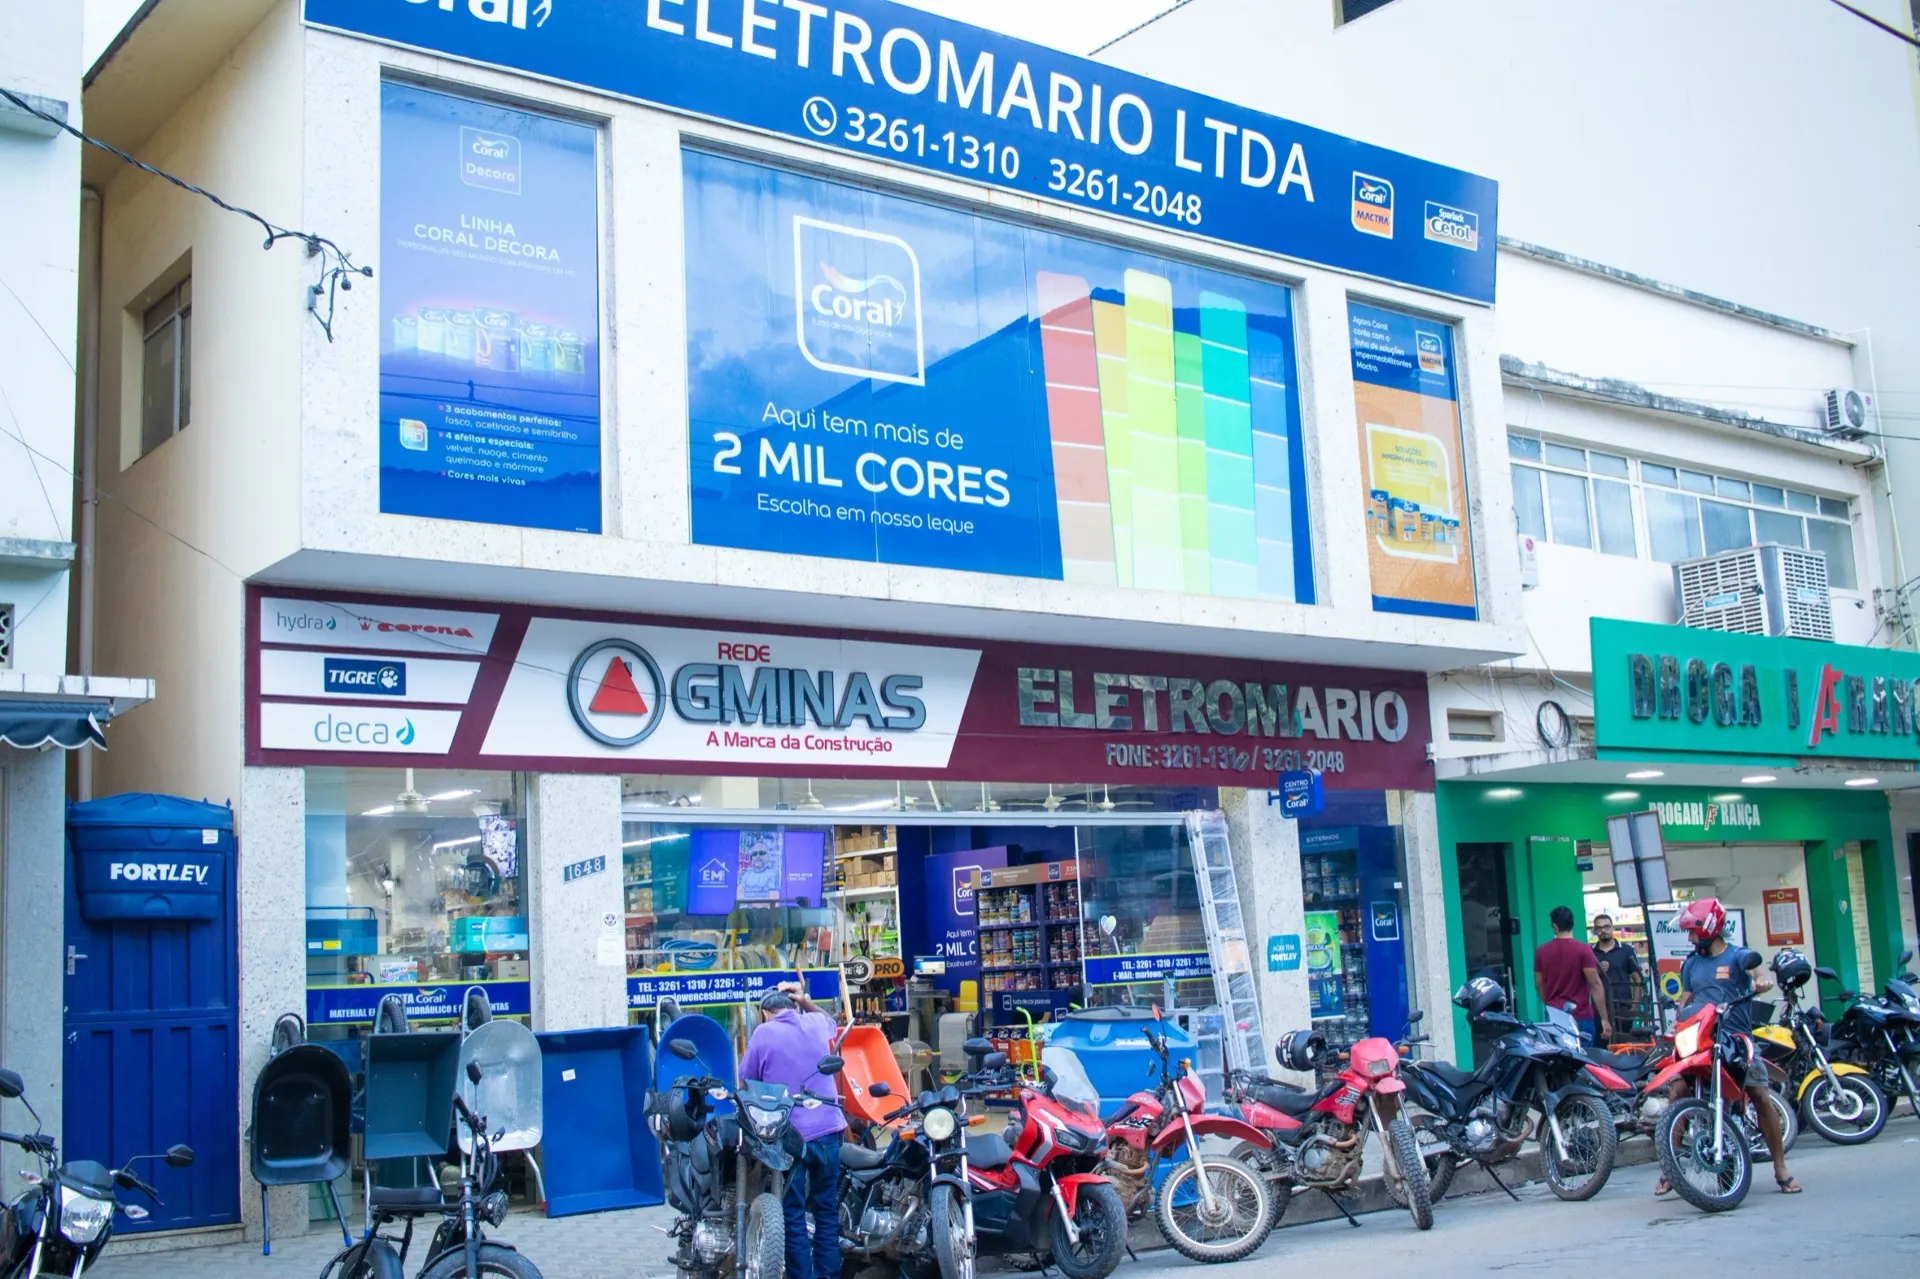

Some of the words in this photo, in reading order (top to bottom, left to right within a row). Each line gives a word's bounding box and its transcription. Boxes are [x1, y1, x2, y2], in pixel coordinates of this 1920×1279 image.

[472, 142, 504, 159] Coral
[1175, 109, 1315, 203] LTDA
[466, 163, 515, 182] Decora
[844, 107, 1020, 180] 3261-1310
[1048, 158, 1202, 226] 3261-2048
[1359, 188, 1384, 204] Coral
[461, 214, 516, 237] LINHA
[1356, 210, 1389, 225] MACTRA
[1430, 217, 1472, 241] Cetol
[414, 224, 479, 248] CORAL
[485, 236, 561, 263] DECORA
[811, 284, 893, 327] Coral
[446, 405, 452, 413] 3
[454, 407, 517, 422] acabamentos
[519, 414, 562, 428] perfeitos:
[762, 401, 816, 432] Aqui
[823, 409, 868, 438] tem
[874, 421, 929, 446] mais
[935, 427, 964, 451] de
[475, 420, 521, 433] acetinado
[531, 425, 578, 441] semibrilho
[446, 432, 452, 440] 4
[454, 432, 486, 444] efeitos
[488, 436, 534, 450] especiais:
[446, 443, 475, 455] velvet,
[478, 447, 510, 459] nuage,
[512, 450, 548, 463] cimento
[446, 455, 492, 468] queimado
[503, 459, 544, 474] mármore
[713, 432, 742, 475] 2
[759, 437, 843, 488] MIL
[855, 452, 1011, 508] CORES
[448, 470, 475, 480] Cores
[477, 473, 499, 483] mais
[501, 477, 526, 486] vivas
[757, 493, 831, 519] Escolha
[836, 506, 866, 523] em
[870, 510, 923, 530] nosso
[927, 515, 975, 536] leque
[277, 612, 323, 630] hydra
[377, 621, 473, 638] corona
[718, 642, 770, 663] REDE
[329, 669, 376, 685] TIGRE
[672, 663, 927, 732] GMINAS
[1018, 667, 1408, 743] ELETROMARIO
[315, 714, 389, 745] deca
[706, 730, 719, 746] A
[724, 732, 776, 749] Marca
[781, 734, 801, 750] da
[805, 735, 893, 756] Construção
[1285, 779, 1308, 788] CENTRO
[1286, 798, 1307, 808] Coral
[1306, 834, 1340, 843] EXTERNOS
[110, 863, 208, 882] FORTLEV
[568, 858, 601, 880] 1648
[957, 887, 973, 898] Cor
[1375, 917, 1392, 927] Coral
[946, 942, 967, 956] MIL
[1271, 953, 1297, 961] FORTLEV
[875, 962, 900, 975] PRO
[658, 981, 680, 991] 3261
[687, 980, 706, 990] 1310
[714, 978, 735, 988] 3261
[741, 977, 763, 987] 048
[416, 995, 442, 1004] Coral
[329, 1006, 365, 1018] MATERIAL
[407, 1005, 452, 1015] HIDRÁULICO
